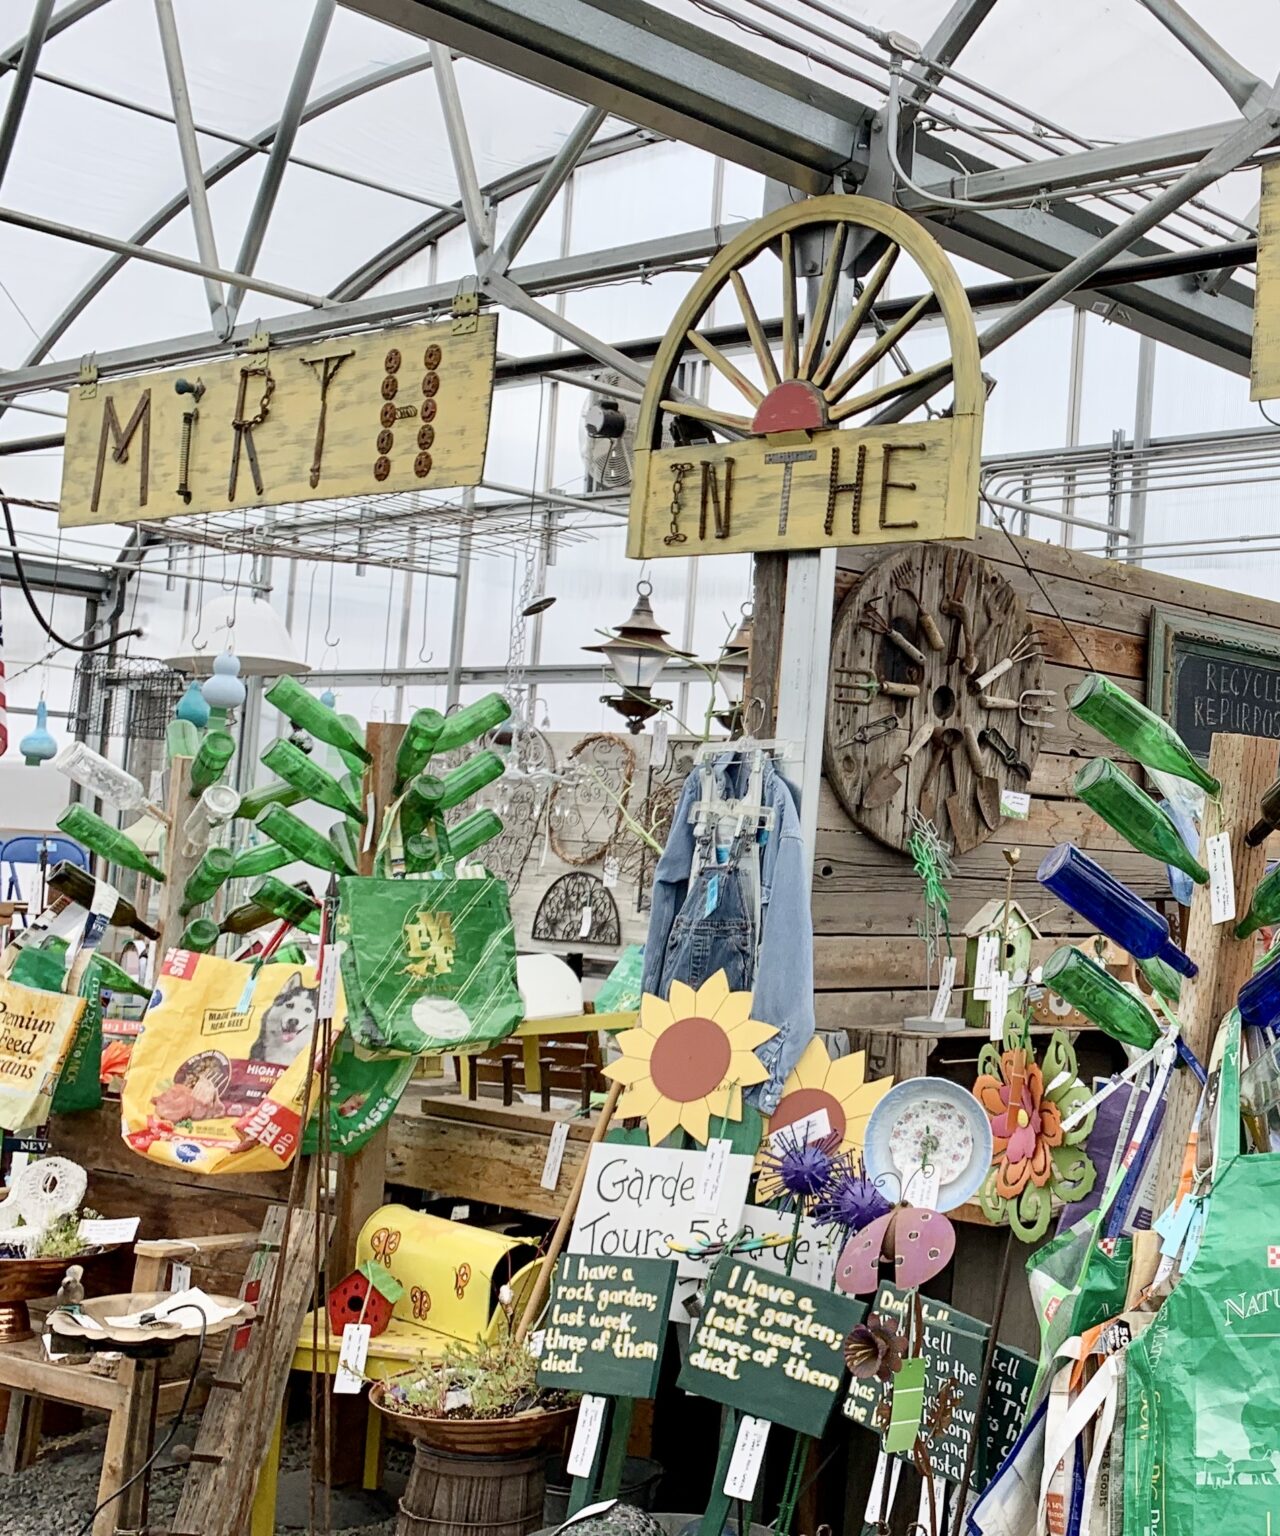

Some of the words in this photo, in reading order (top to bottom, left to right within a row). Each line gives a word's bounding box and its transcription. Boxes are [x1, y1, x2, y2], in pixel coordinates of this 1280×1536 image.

[664, 457, 735, 545] IN
[764, 442, 928, 537] THE
[0, 1027, 37, 1055] Feed
[246, 1064, 276, 1077] HIGH
[597, 1158, 696, 1208] Garde
[579, 1212, 673, 1259] Tours
[563, 1257, 570, 1280] I
[577, 1257, 618, 1281] have
[621, 1267, 635, 1282] a
[557, 1281, 595, 1302] rock
[596, 1286, 658, 1312] garden;
[728, 1265, 742, 1289] I
[742, 1270, 796, 1306] have
[798, 1297, 818, 1313] a
[552, 1304, 586, 1327] last
[704, 1306, 749, 1336] last
[712, 1289, 761, 1319] rock
[759, 1307, 844, 1351] garden;
[545, 1328, 588, 1353] three
[590, 1330, 611, 1352] of
[611, 1333, 658, 1361] them
[923, 1326, 952, 1356] tell
[541, 1351, 583, 1374] died.
[696, 1326, 752, 1362] three
[752, 1347, 779, 1368] of
[782, 1356, 840, 1392] them
[936, 1355, 950, 1373] in
[952, 1359, 977, 1387] the
[848, 1376, 876, 1402] has
[995, 1376, 1013, 1396] in
[842, 1397, 868, 1422] the
[941, 1441, 968, 1463] and
